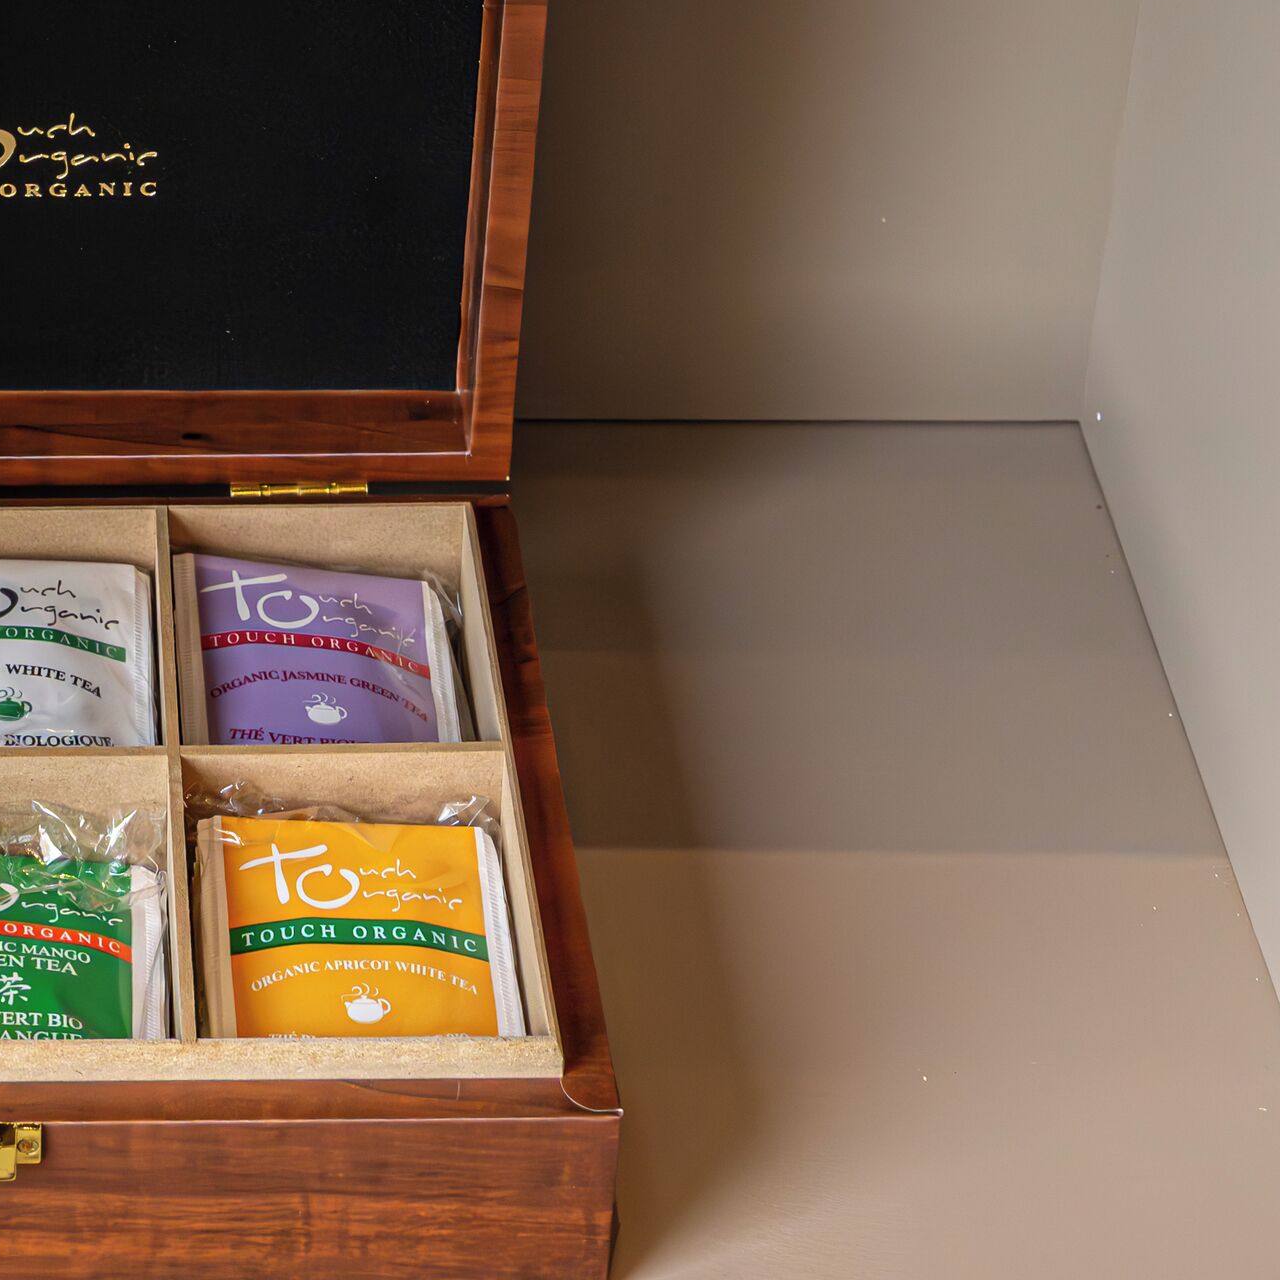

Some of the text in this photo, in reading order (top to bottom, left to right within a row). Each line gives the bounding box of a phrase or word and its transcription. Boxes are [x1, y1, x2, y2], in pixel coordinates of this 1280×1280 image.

[0, 181, 158, 199] ORGANIC
[5, 627, 119, 658] ORGANIC
[210, 631, 420, 673] TOUCH ORGANIC
[5, 663, 67, 682] WHITE
[70, 673, 103, 699] TEA
[210, 669, 429, 724] ORGANIC JASMINE GREEN TEA
[229, 727, 265, 742] THÉ
[268, 731, 316, 744] VERT
[3, 922, 121, 954] ORGANIC
[241, 923, 478, 954] TOUCH ORGANIC
[21, 943, 92, 966] MANGO
[30, 957, 79, 977] TEA
[250, 958, 478, 996] ORGANIC APRICOT WHITE TEA
[47, 1013, 84, 1031] BIO
